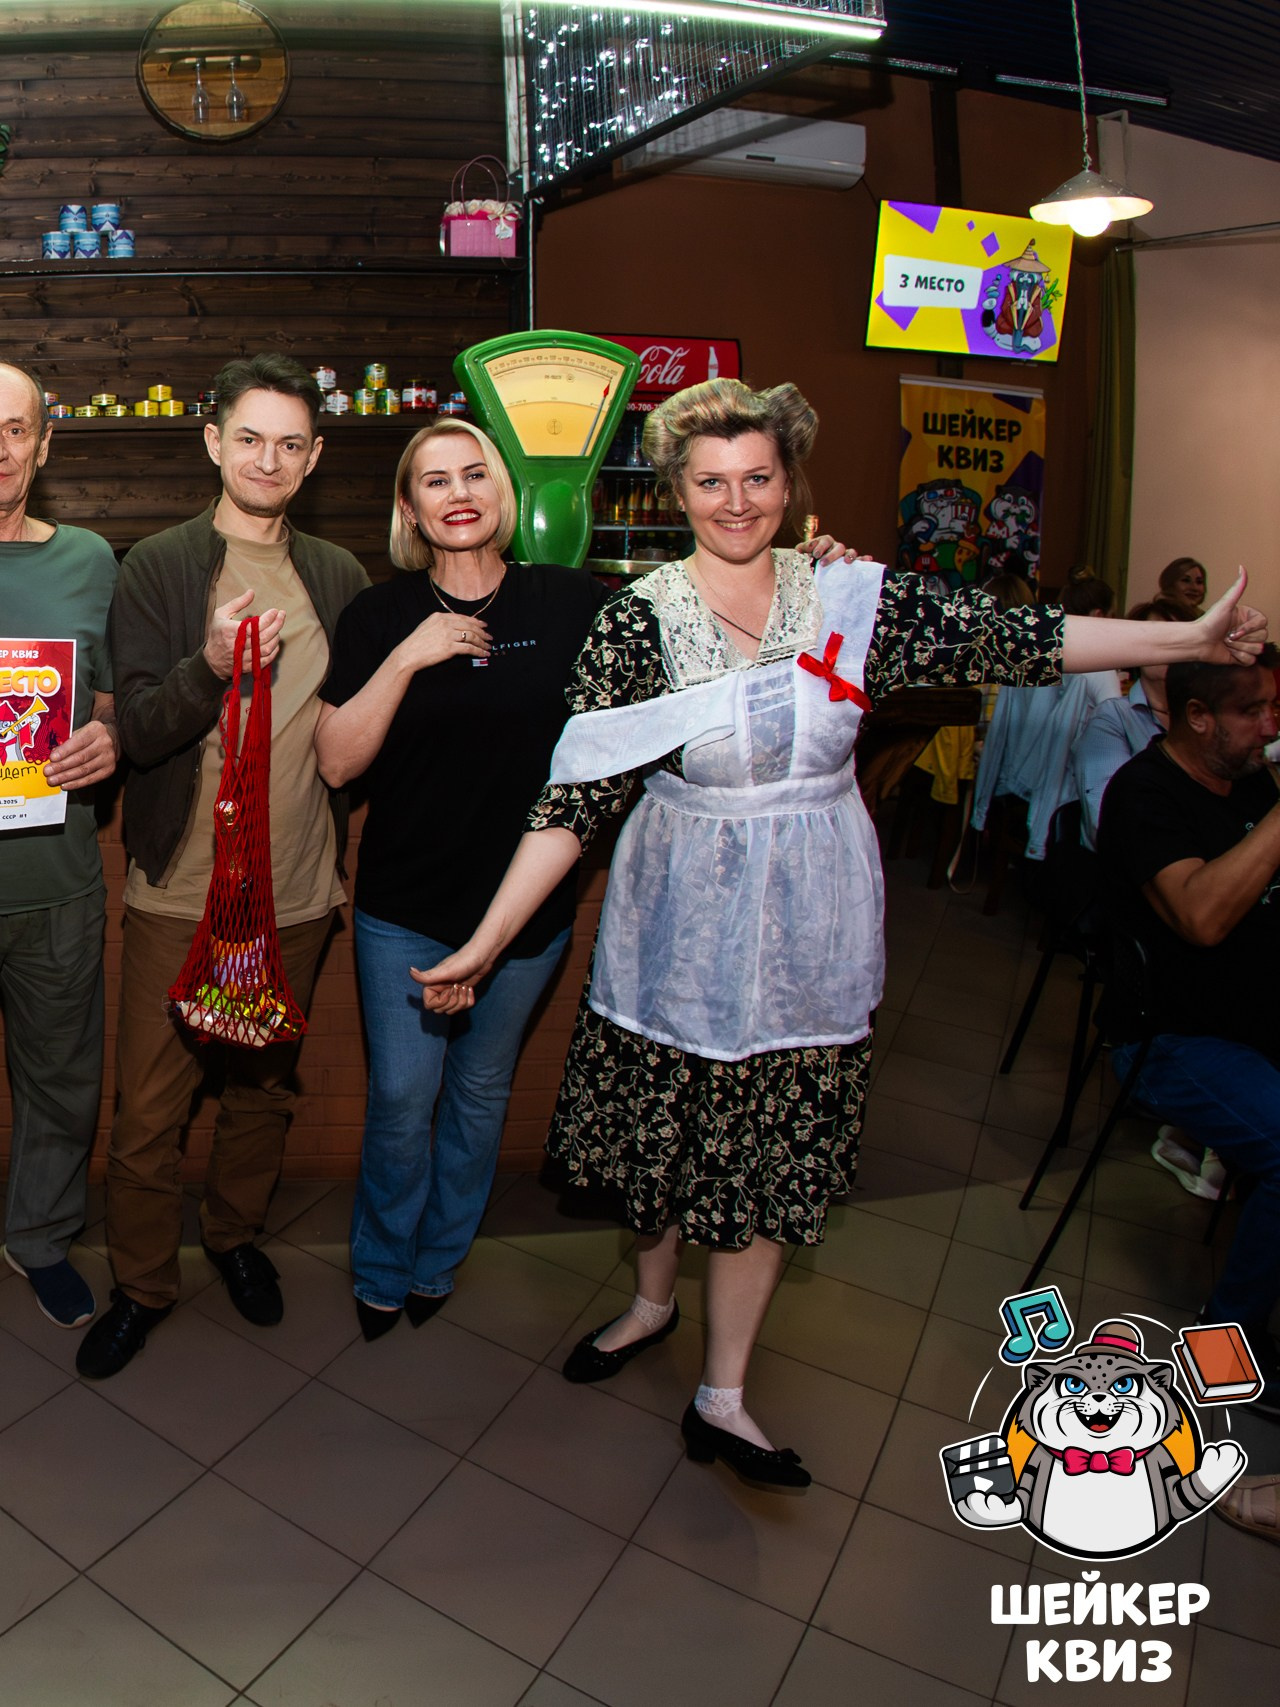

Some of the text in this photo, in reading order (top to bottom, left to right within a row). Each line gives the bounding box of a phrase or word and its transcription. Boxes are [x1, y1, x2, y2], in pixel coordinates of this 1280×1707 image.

[898, 273, 966, 294] 3 МЕСТО
[922, 408, 1023, 444] ШЕЙКЕР
[936, 444, 1005, 474] КВИЗ
[11, 650, 39, 659] КВИЗ
[492, 640, 536, 650] LFIGER
